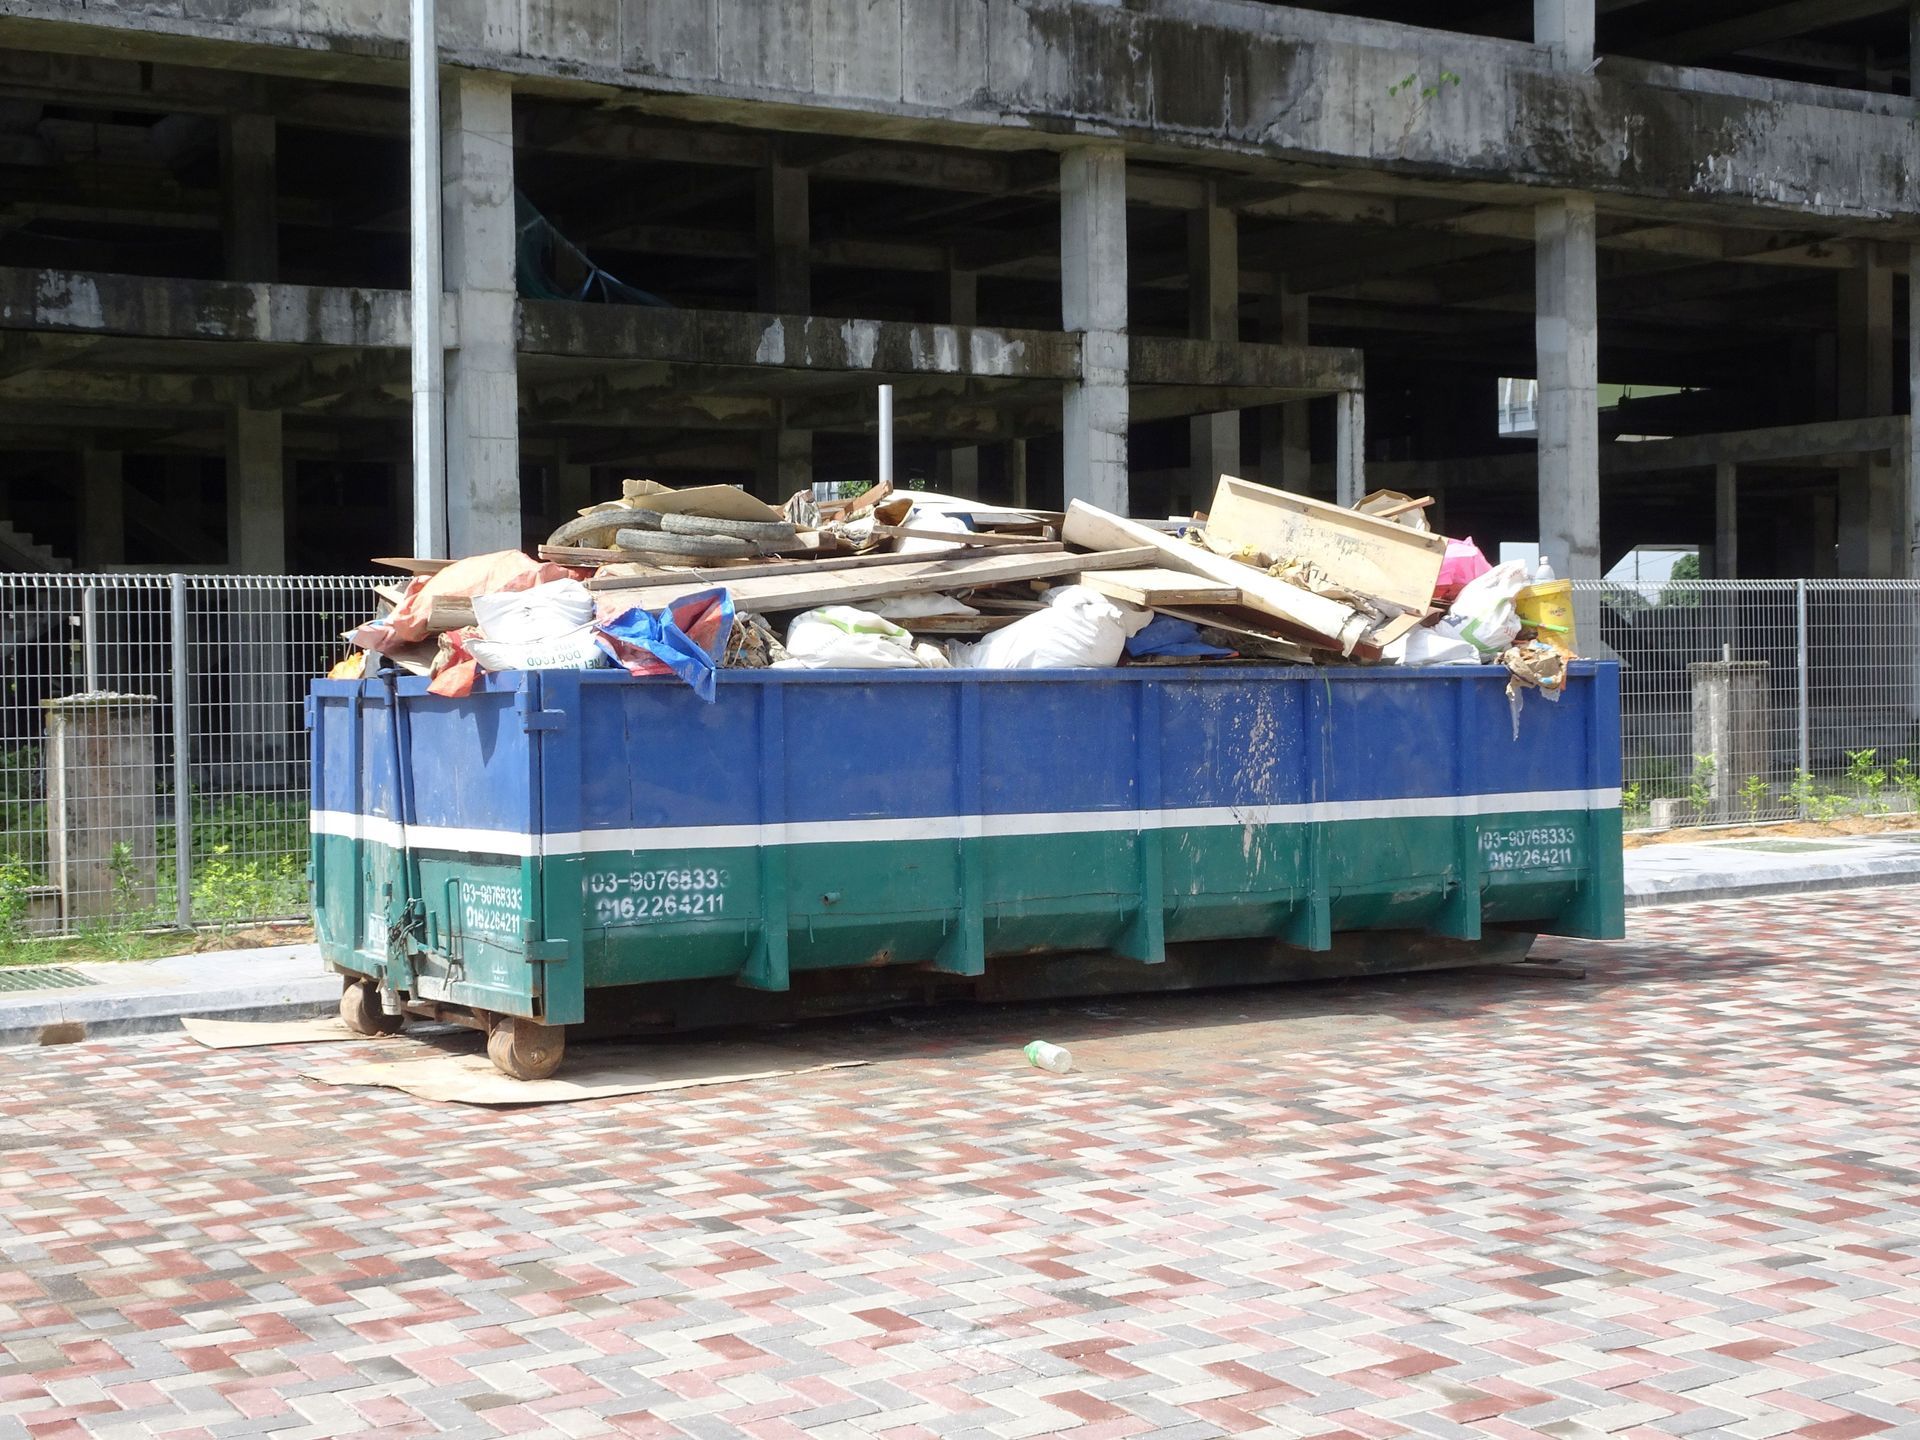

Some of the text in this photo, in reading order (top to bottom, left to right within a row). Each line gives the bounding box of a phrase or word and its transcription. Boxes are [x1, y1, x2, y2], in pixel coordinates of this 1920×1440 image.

[558, 650, 582, 663] DOG
[1483, 828, 1575, 850] 03-90768333
[1490, 848, 1572, 869] 0162264211
[591, 868, 732, 894] 03-90768333
